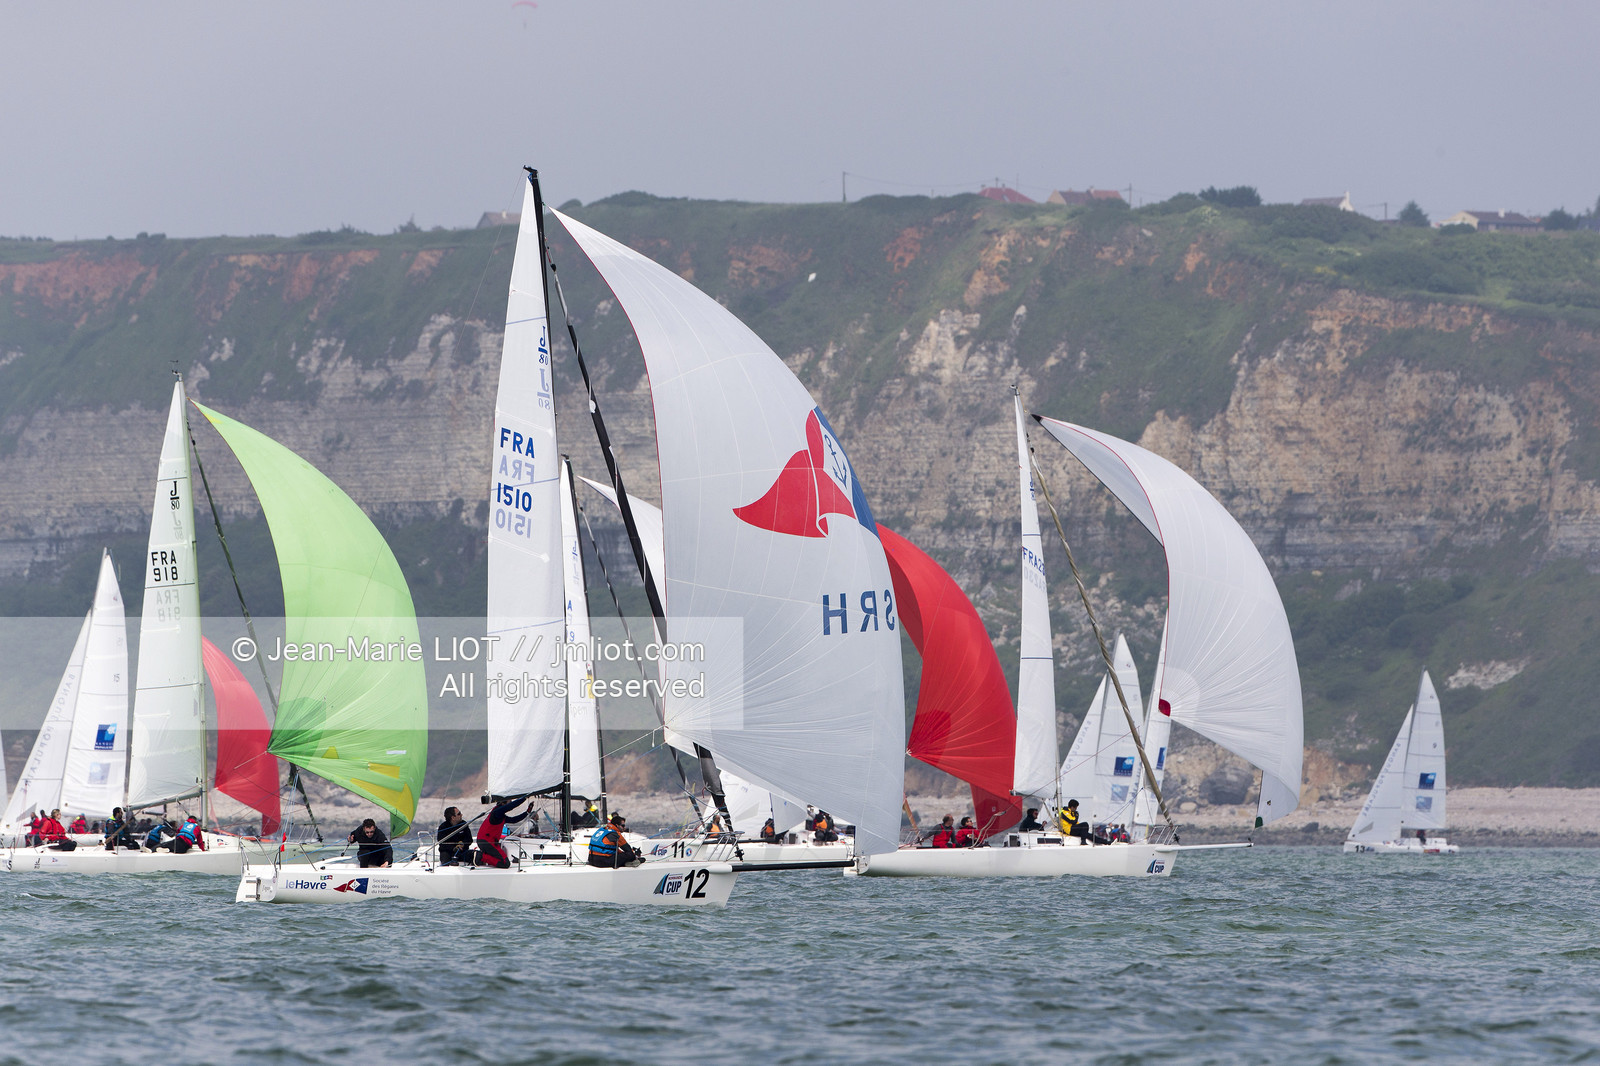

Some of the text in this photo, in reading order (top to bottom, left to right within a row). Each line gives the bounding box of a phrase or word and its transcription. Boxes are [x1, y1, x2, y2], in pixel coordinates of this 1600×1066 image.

[538, 353, 549, 365] 80
[500, 427, 536, 459] FRA
[170, 480, 178, 497] J
[170, 500, 180, 511] 80
[496, 482, 533, 513] 1510
[151, 550, 178, 567] FRA
[153, 566, 179, 582] 918
[671, 841, 685, 858] 11
[285, 879, 327, 890] leHavre
[666, 880, 682, 893] CUP
[684, 868, 710, 899] 12
